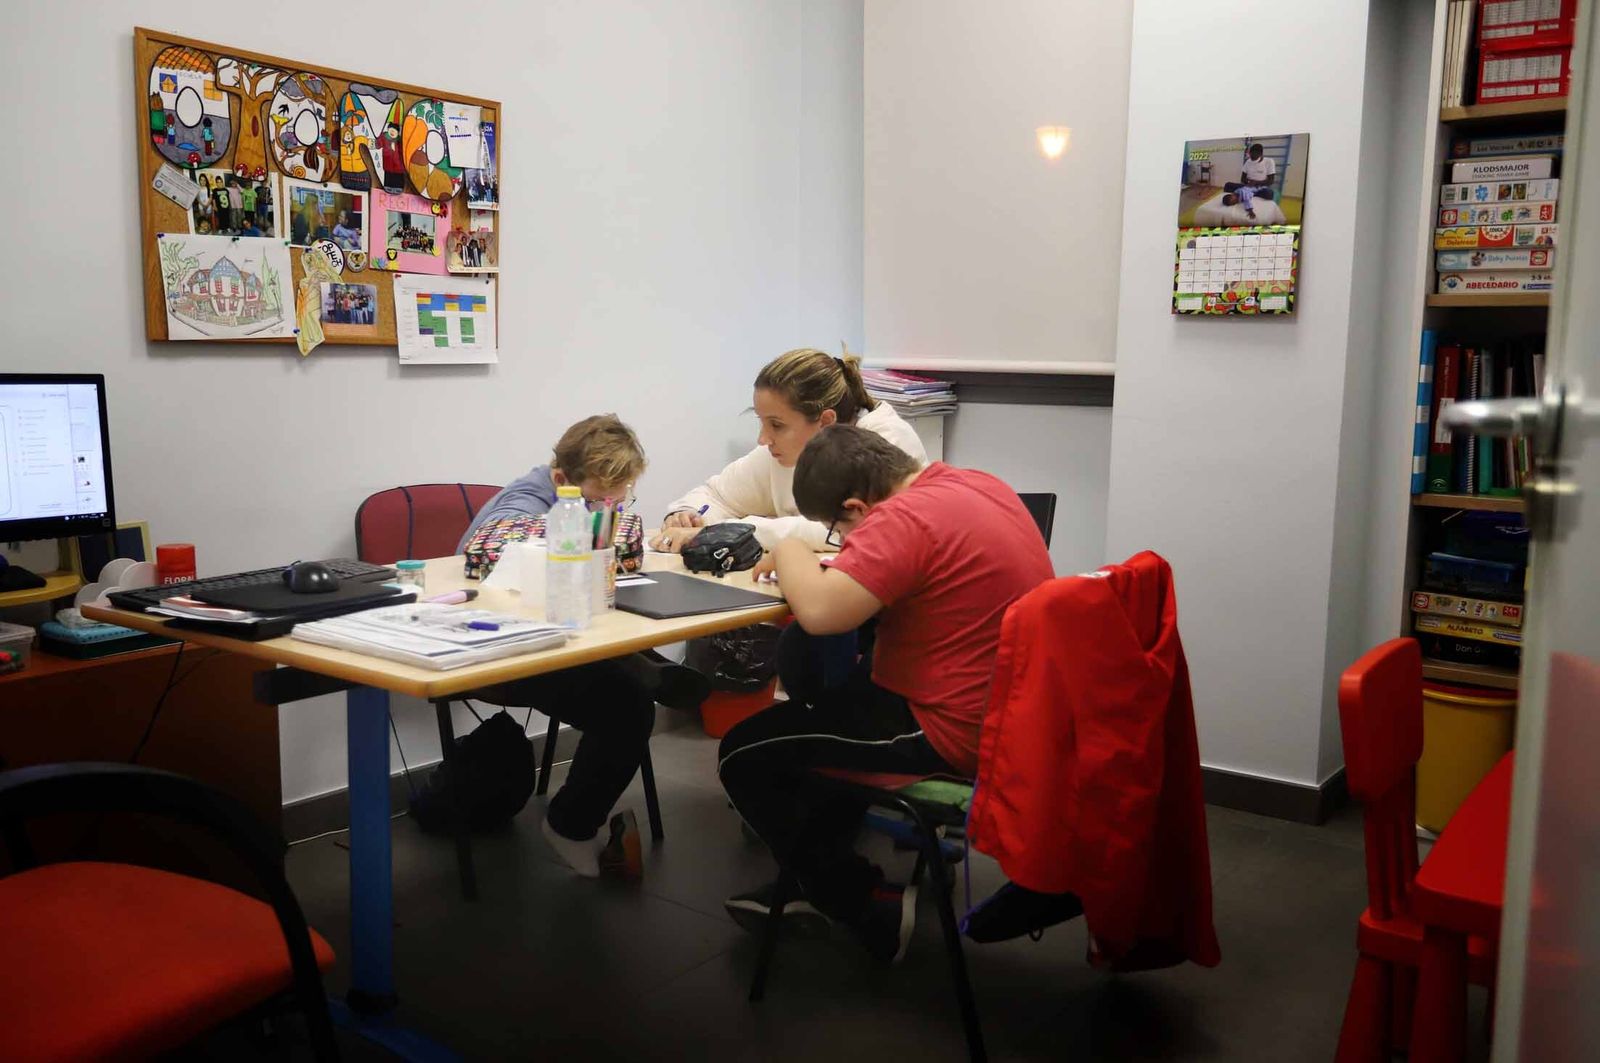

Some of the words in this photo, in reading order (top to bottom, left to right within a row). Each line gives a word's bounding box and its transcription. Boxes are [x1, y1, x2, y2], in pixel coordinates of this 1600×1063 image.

[1189, 152, 1209, 161] 2022
[1473, 163, 1530, 173] KLODSMAJOR
[1466, 280, 1519, 289] ABECEDARIO
[1447, 624, 1483, 635] ALFABETO
